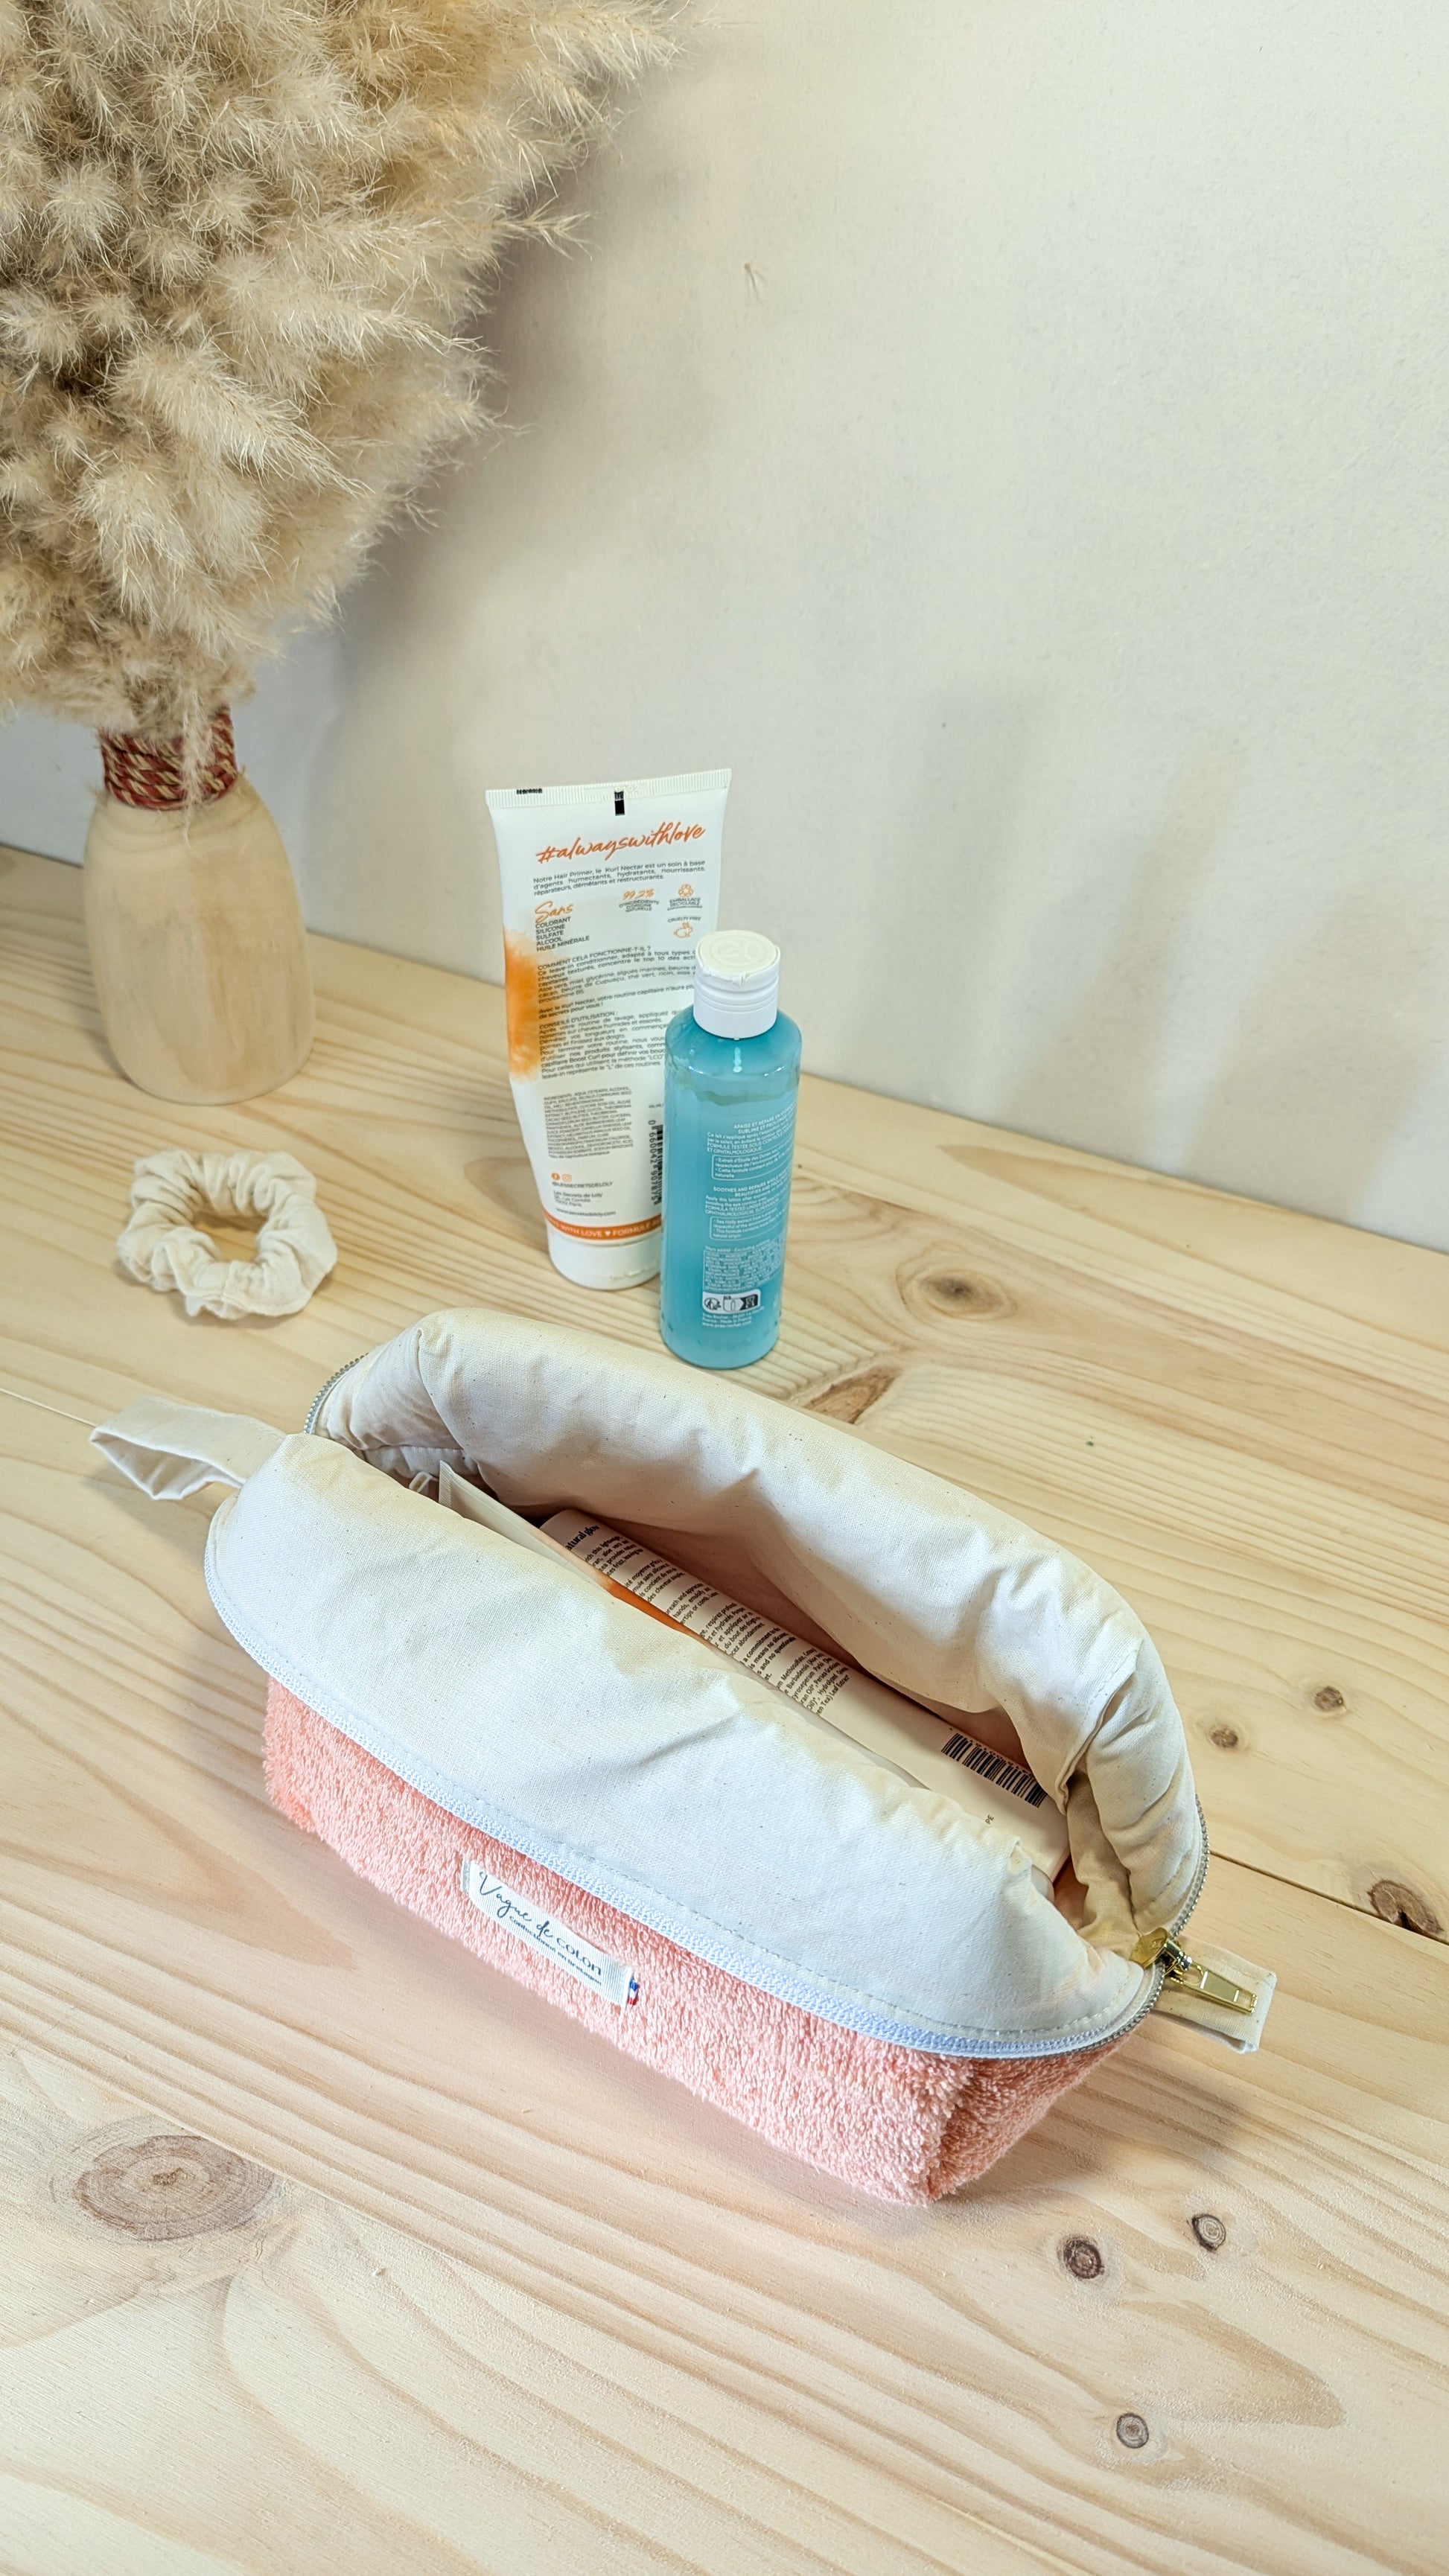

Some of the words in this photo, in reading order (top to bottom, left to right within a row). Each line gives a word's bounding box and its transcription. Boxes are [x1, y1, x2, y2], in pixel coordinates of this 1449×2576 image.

[536, 822, 705, 864] #alwayswithlove
[534, 880, 564, 890] d'agents
[569, 874, 612, 883] humectants,
[573, 880, 608, 889] démêlants
[535, 901, 573, 923] Sans
[535, 916, 571, 929] COLORANT
[536, 924, 566, 935] SILICONE
[536, 930, 564, 941] SULFATE
[536, 937, 563, 946] ALCOOL
[536, 943, 556, 951] HUILE
[557, 935, 590, 947] MINÉRALE
[538, 958, 570, 971] COMMENT
[538, 972, 565, 981] cheveux
[598, 959, 631, 968] concentre
[550, 964, 575, 974] leave-in
[637, 987, 664, 995] capillaire
[539, 1019, 570, 1029] CONSEILS
[578, 1025, 603, 1033] cheveux
[585, 1029, 615, 1037] longueurs
[585, 1048, 611, 1056] produits
[541, 1059, 568, 1068] capillaire
[567, 1066, 599, 1075] représente
[566, 1531, 586, 1552] atural
[593, 1546, 602, 1555] this
[602, 1548, 612, 1557] aloe
[631, 1565, 651, 1581] moyenne
[643, 1572, 654, 1583] sans
[643, 1577, 661, 1592] contient
[678, 1592, 687, 1602] and
[673, 1604, 690, 1619] hands,
[707, 1611, 722, 1629] respirez
[724, 1617, 743, 1636] appliquez
[724, 1641, 732, 1650] du
[730, 1631, 742, 1642] bout
[755, 1647, 769, 1665] means
[768, 1642, 774, 1650] no
[761, 1659, 770, 1671] and
[786, 1660, 810, 1689] Barbadensis
[821, 1694, 834, 1708] Tea)
[829, 1686, 838, 1696] Leaf
[985, 1814, 995, 1824] PE
[480, 1872, 532, 1921] Vague
[536, 1921, 552, 1937] de
